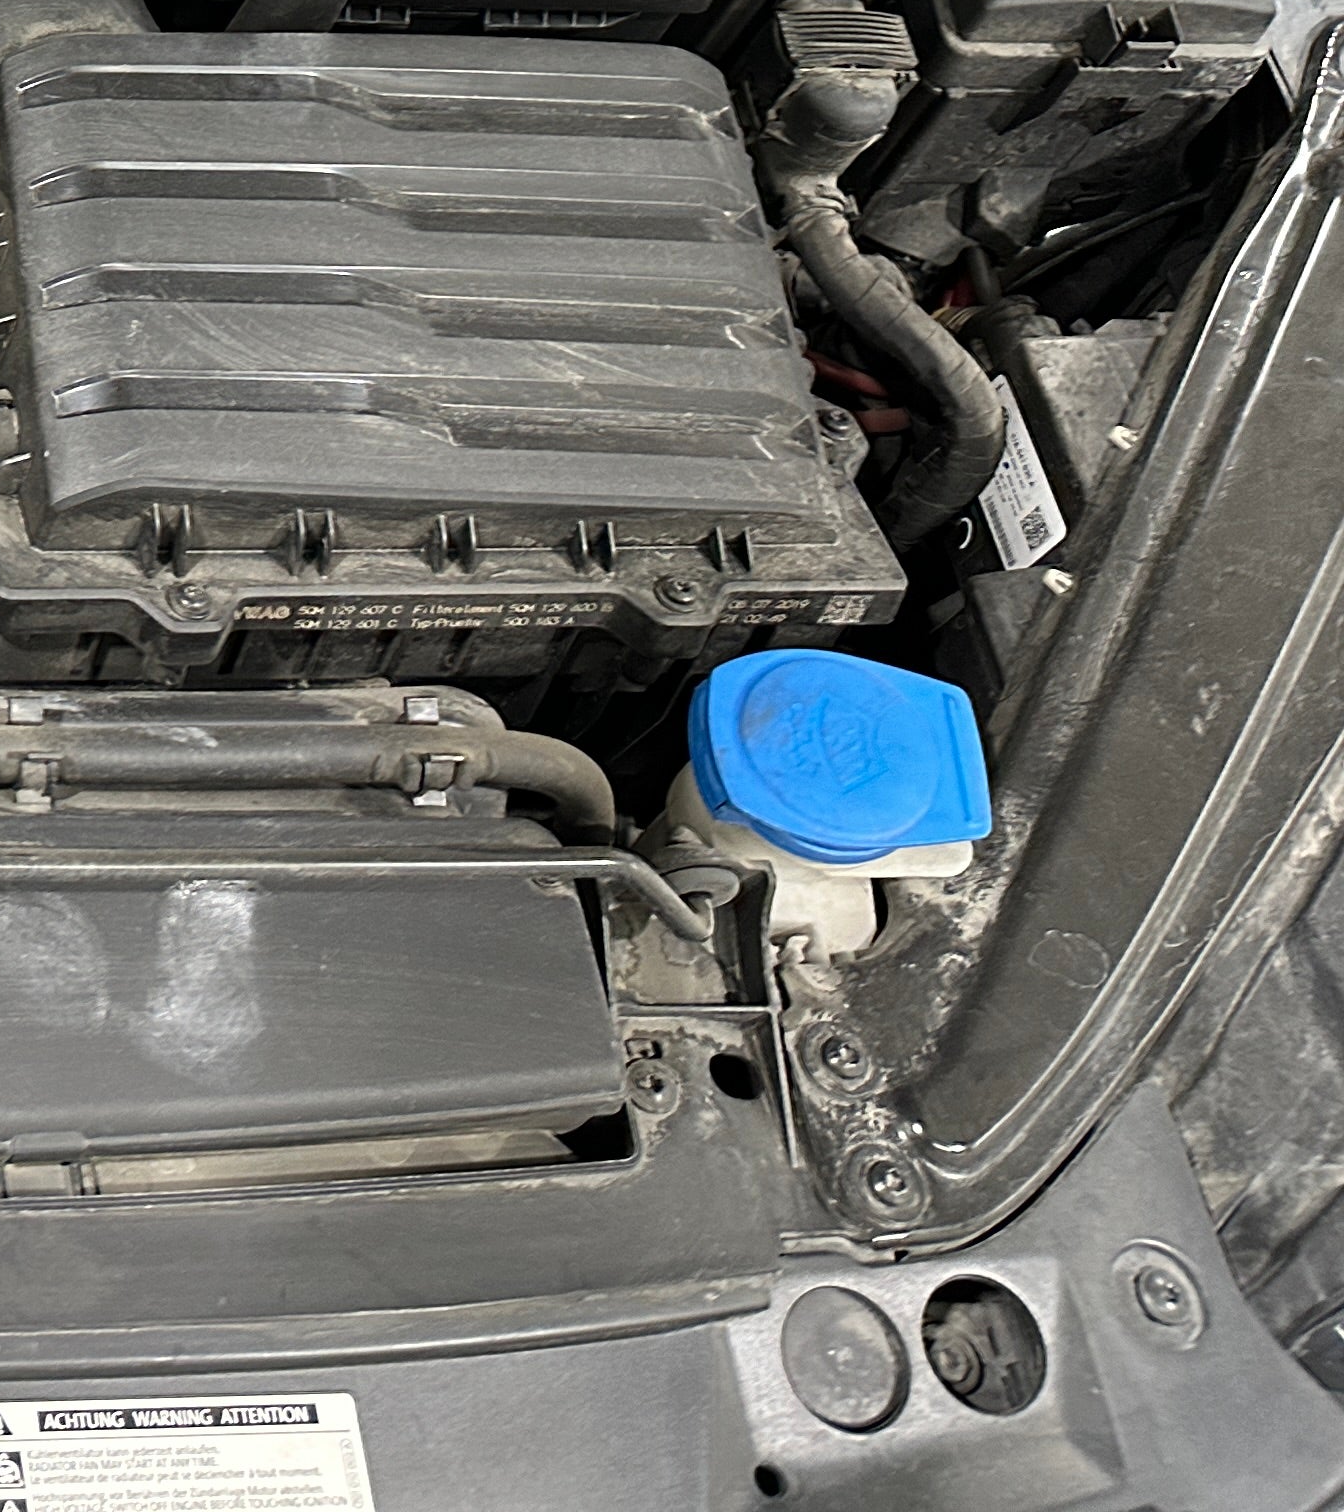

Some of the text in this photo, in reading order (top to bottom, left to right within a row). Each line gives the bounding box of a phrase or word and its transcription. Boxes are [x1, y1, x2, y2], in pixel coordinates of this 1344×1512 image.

[44, 1406, 310, 1429] ACHTUNG WARNING ATTENTION
